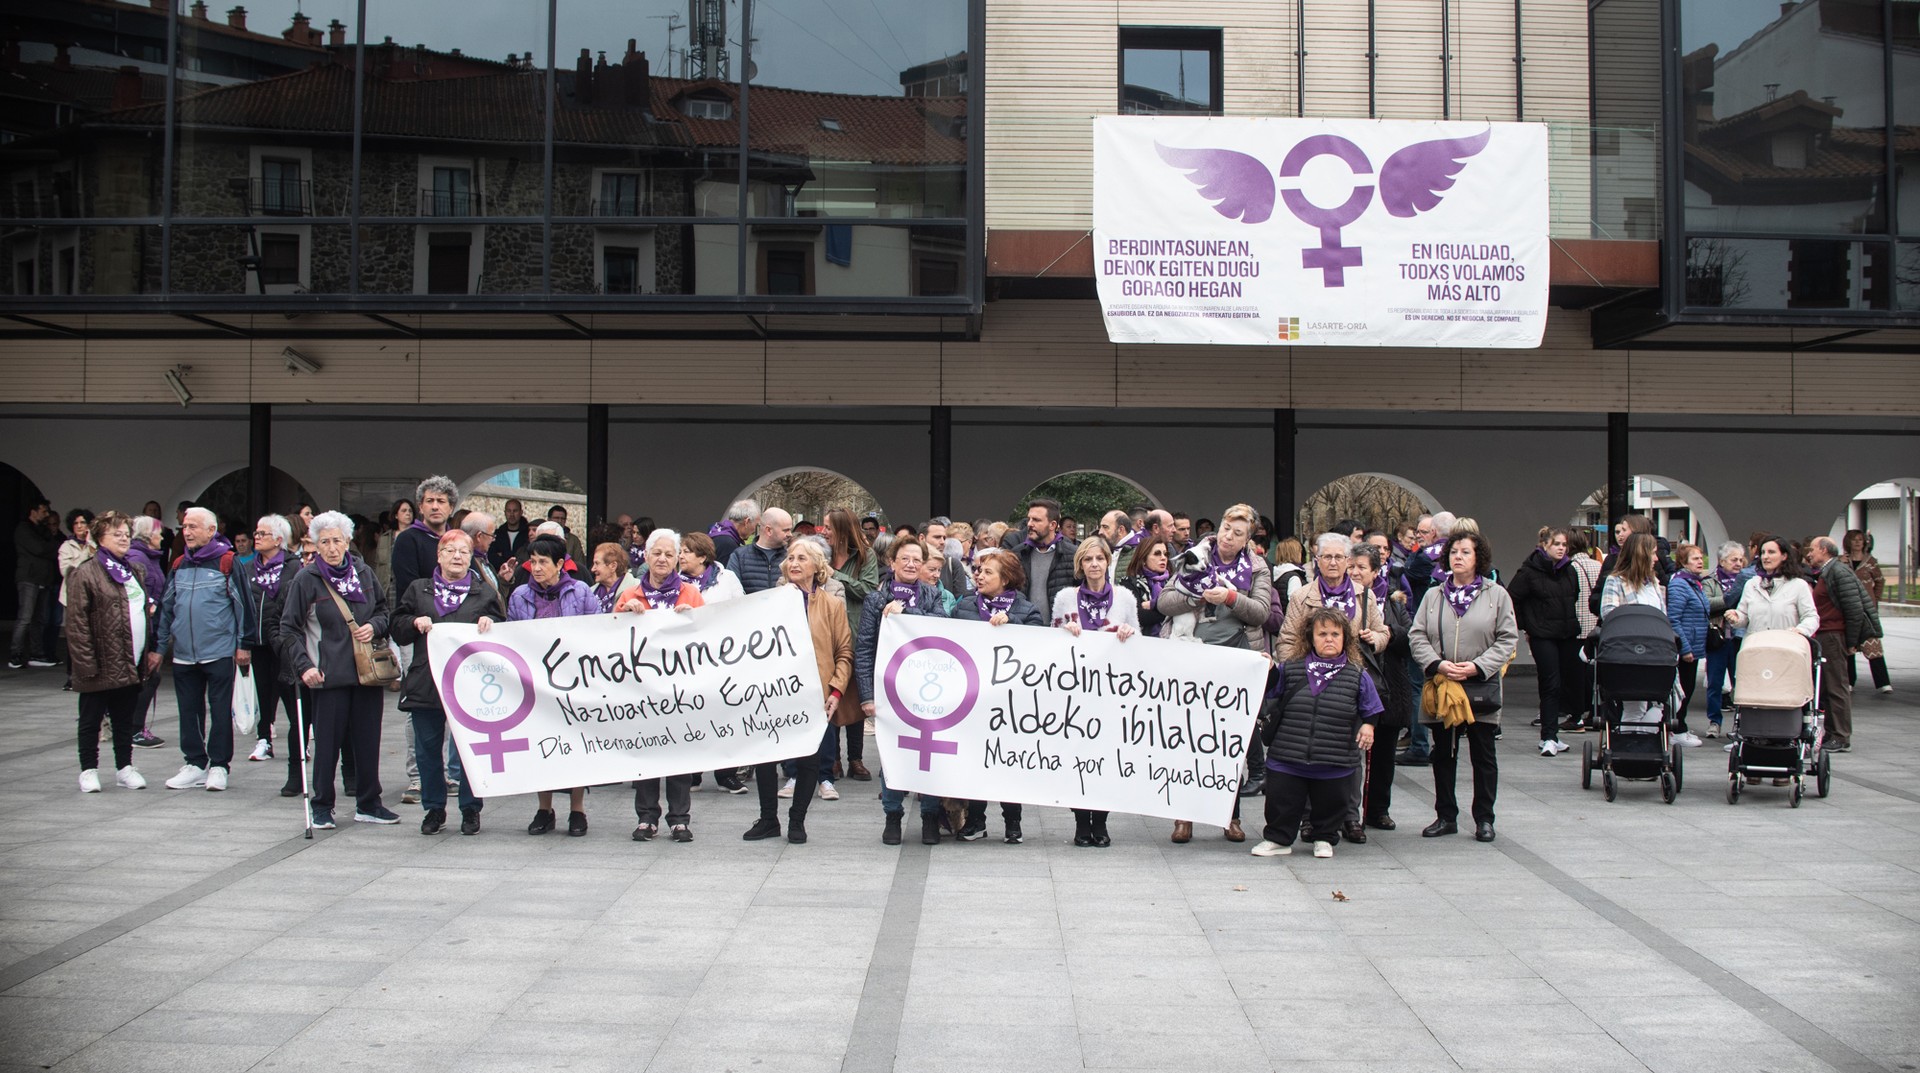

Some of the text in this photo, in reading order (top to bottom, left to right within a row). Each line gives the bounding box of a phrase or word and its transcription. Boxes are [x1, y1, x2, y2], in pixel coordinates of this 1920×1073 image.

[1108, 239, 1254, 259] BERDINTASUNEAN,
[1412, 243, 1515, 263] EN IGUALDAD,
[1104, 259, 1260, 278] DENOK EGITEN DUGU
[1399, 263, 1525, 282] TODXS VOLAMOS
[1122, 279, 1242, 298] GORAGO HEGAN
[1428, 280, 1501, 302] MÁS ALTO
[1306, 322, 1368, 330] LASARTE-ORIA
[480, 673, 503, 704] 8
[919, 672, 943, 702] 8
[991, 645, 1249, 716] Berdintasunaren
[719, 674, 804, 715] Eguna
[475, 705, 508, 717] marzo
[537, 710, 809, 759] Día Internacional de las Mujeres
[1121, 704, 1244, 759] ibilaldia
[984, 736, 1239, 806] Marcha por la igualdad
